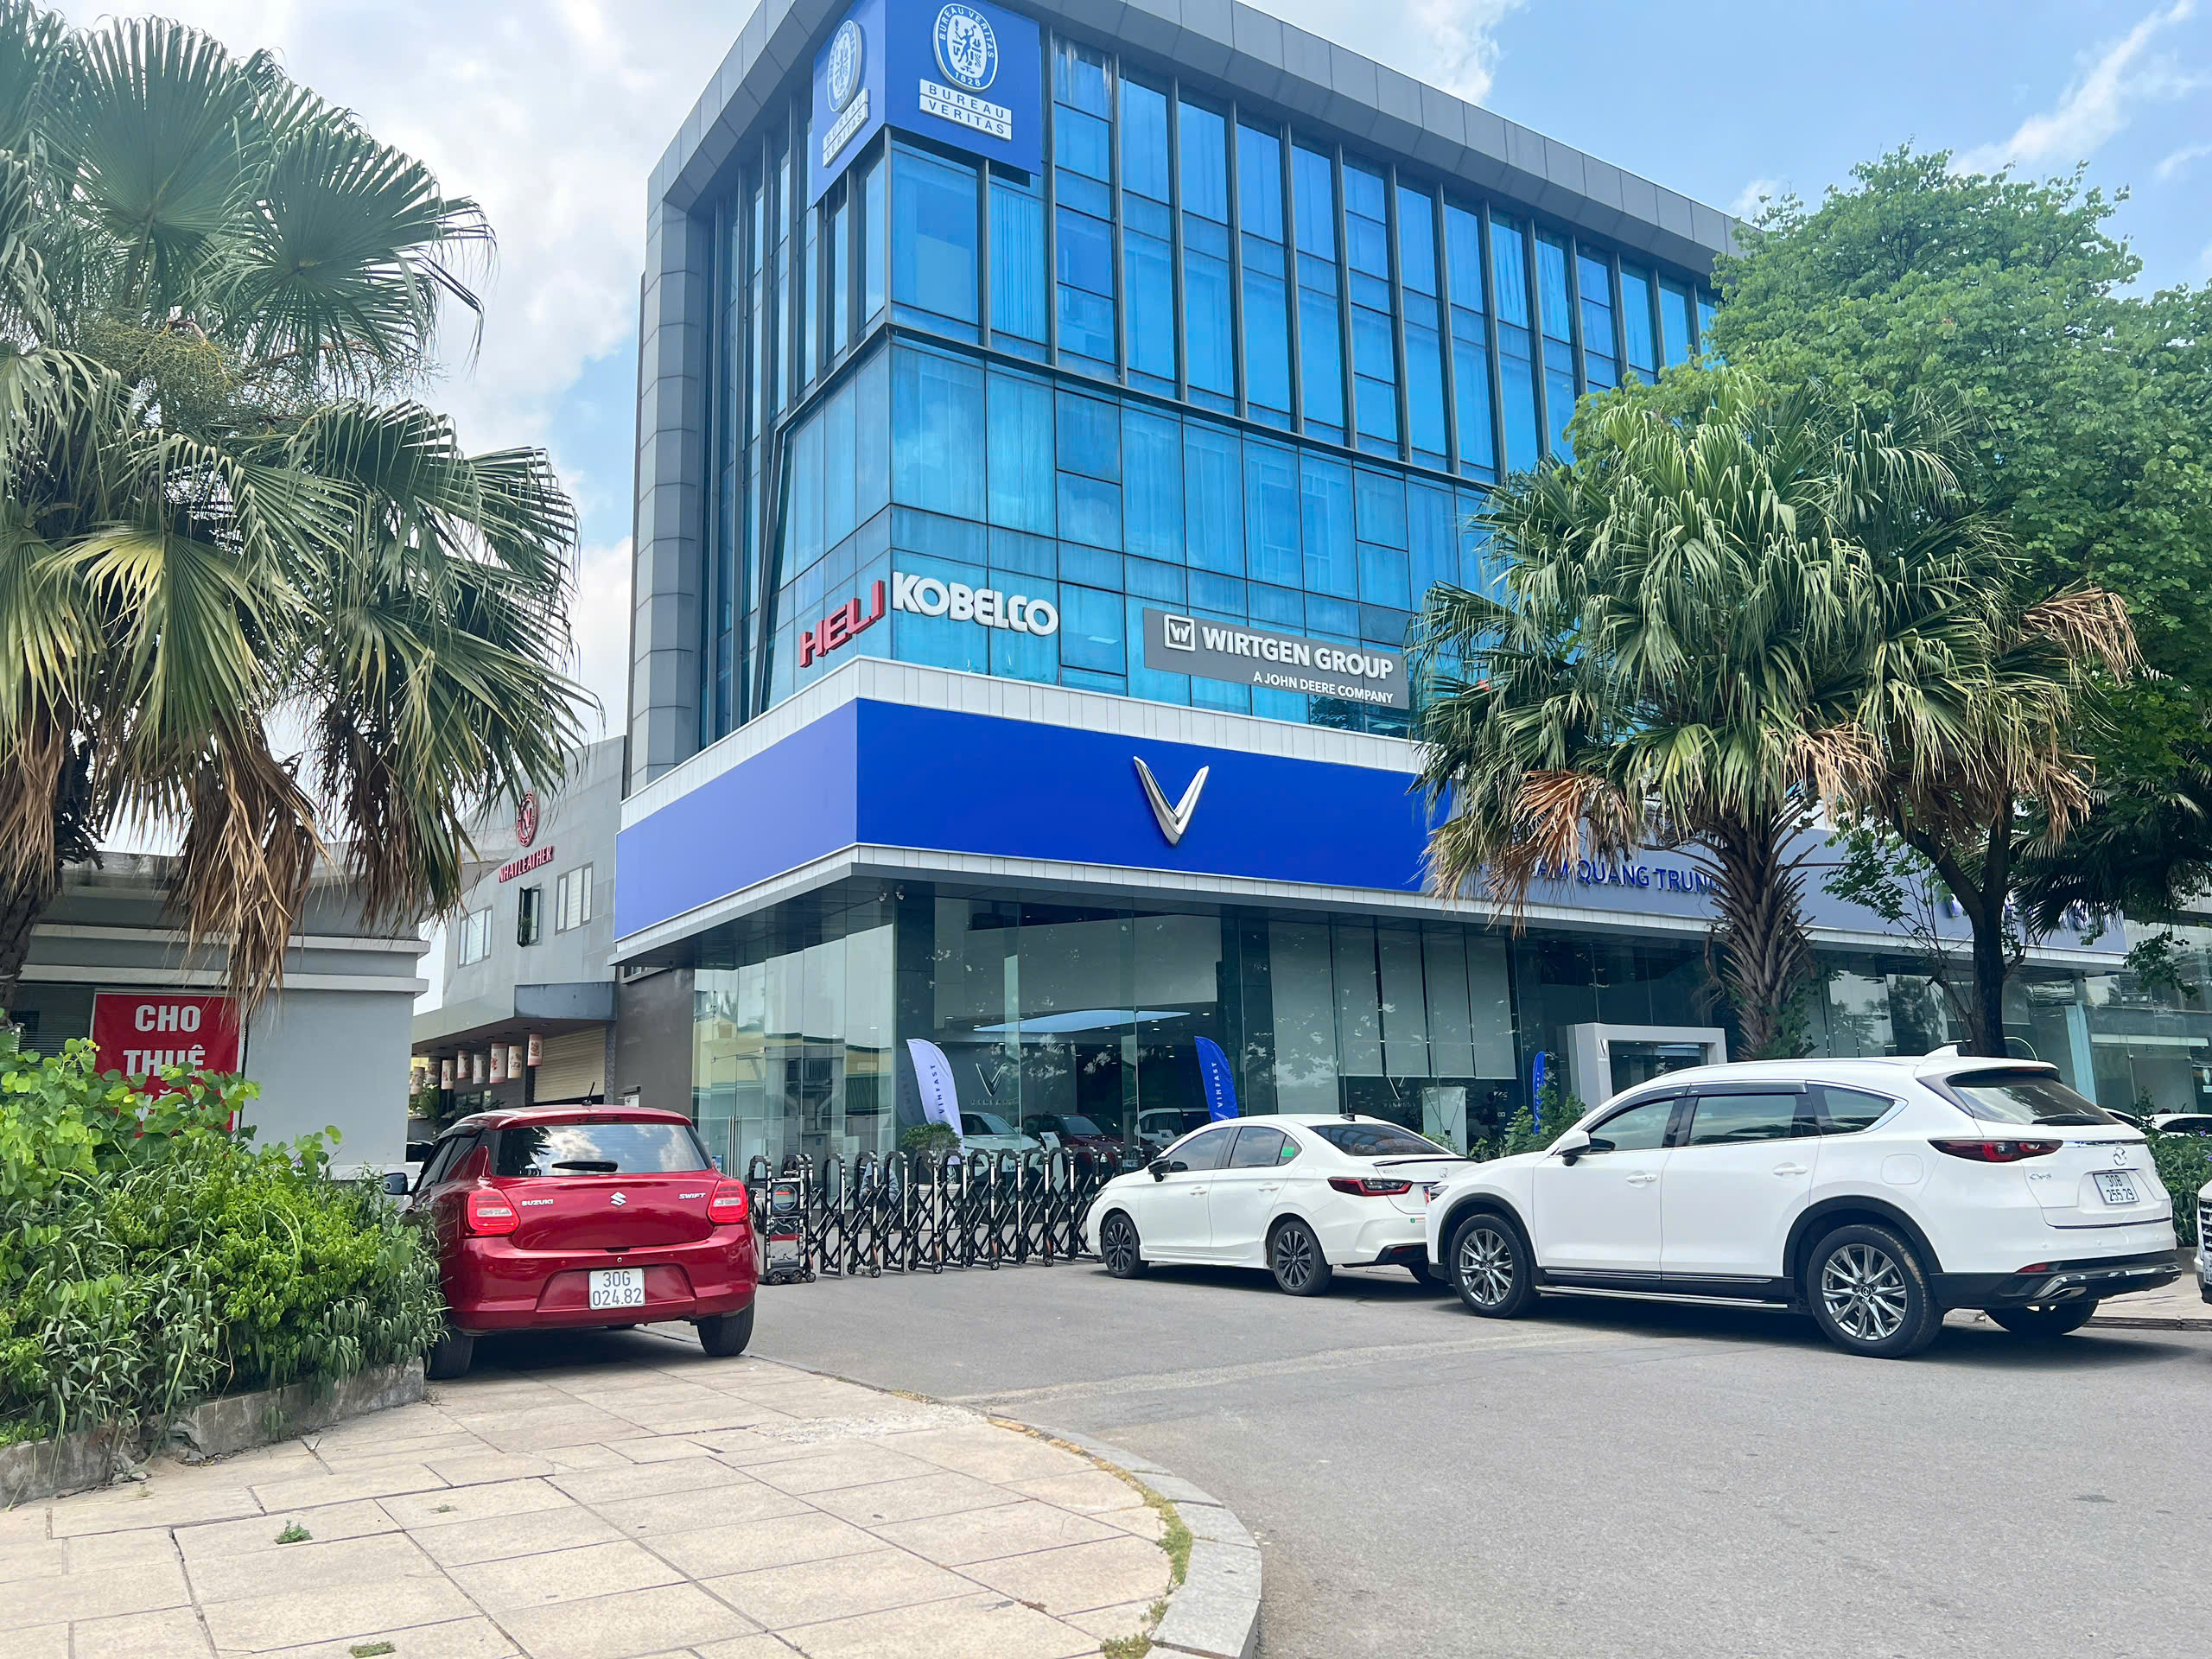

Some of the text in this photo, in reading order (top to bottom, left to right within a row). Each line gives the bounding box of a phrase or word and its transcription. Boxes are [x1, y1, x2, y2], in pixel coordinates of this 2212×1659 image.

[939, 7, 995, 59] BUREAU VERITAS
[955, 72, 981, 86] 1828
[929, 84, 1004, 118] BUREAU
[929, 99, 1004, 134] VERITAS
[826, 95, 862, 143] BUREAU
[826, 111, 862, 159] VERITAS
[892, 571, 1058, 637] KOBELCO
[799, 580, 886, 668] HELI
[1201, 626, 1310, 667] WIRTGEN
[1313, 647, 1393, 679] GROUP
[1253, 671, 1394, 704] A JOHN DEERE COMPANY
[1577, 859, 1649, 887] QUANG
[135, 1004, 201, 1033] CHO
[123, 1044, 206, 1077] THUÊ
[930, 1065, 945, 1115] VINFAST
[1211, 1062, 1224, 1109] VINFAST
[602, 1270, 631, 1287] 30G
[592, 1287, 643, 1306] 024.82
